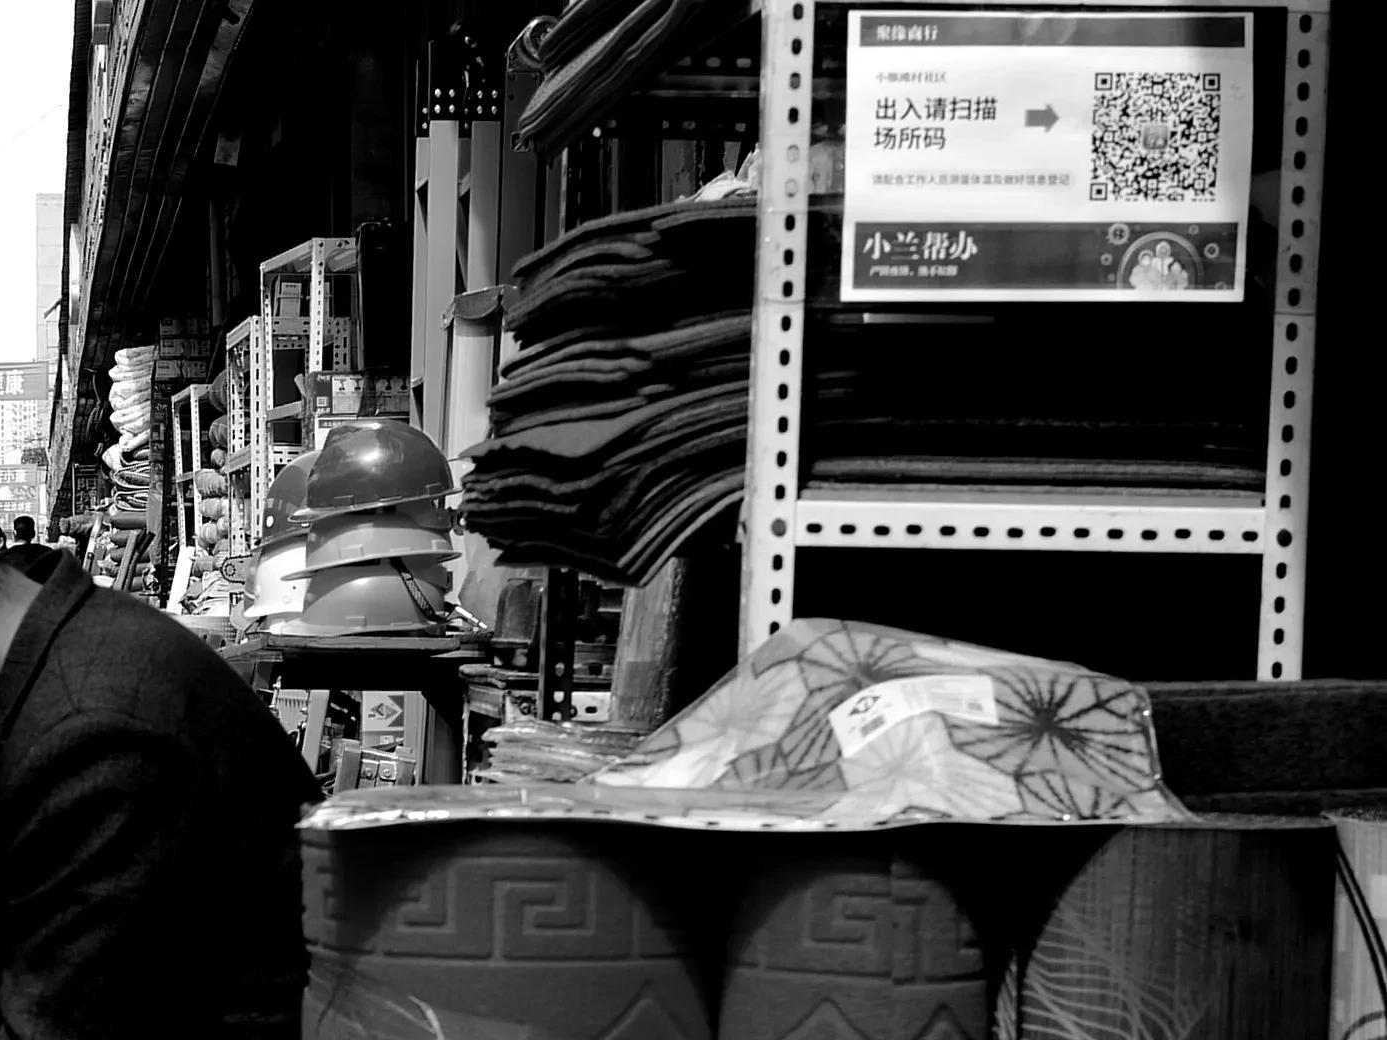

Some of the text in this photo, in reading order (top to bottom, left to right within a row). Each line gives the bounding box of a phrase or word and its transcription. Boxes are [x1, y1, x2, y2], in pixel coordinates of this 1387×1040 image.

[875, 97, 998, 120] 出入请扫描
[874, 127, 946, 150] 场所码
[862, 229, 978, 260] 小兰帮办
